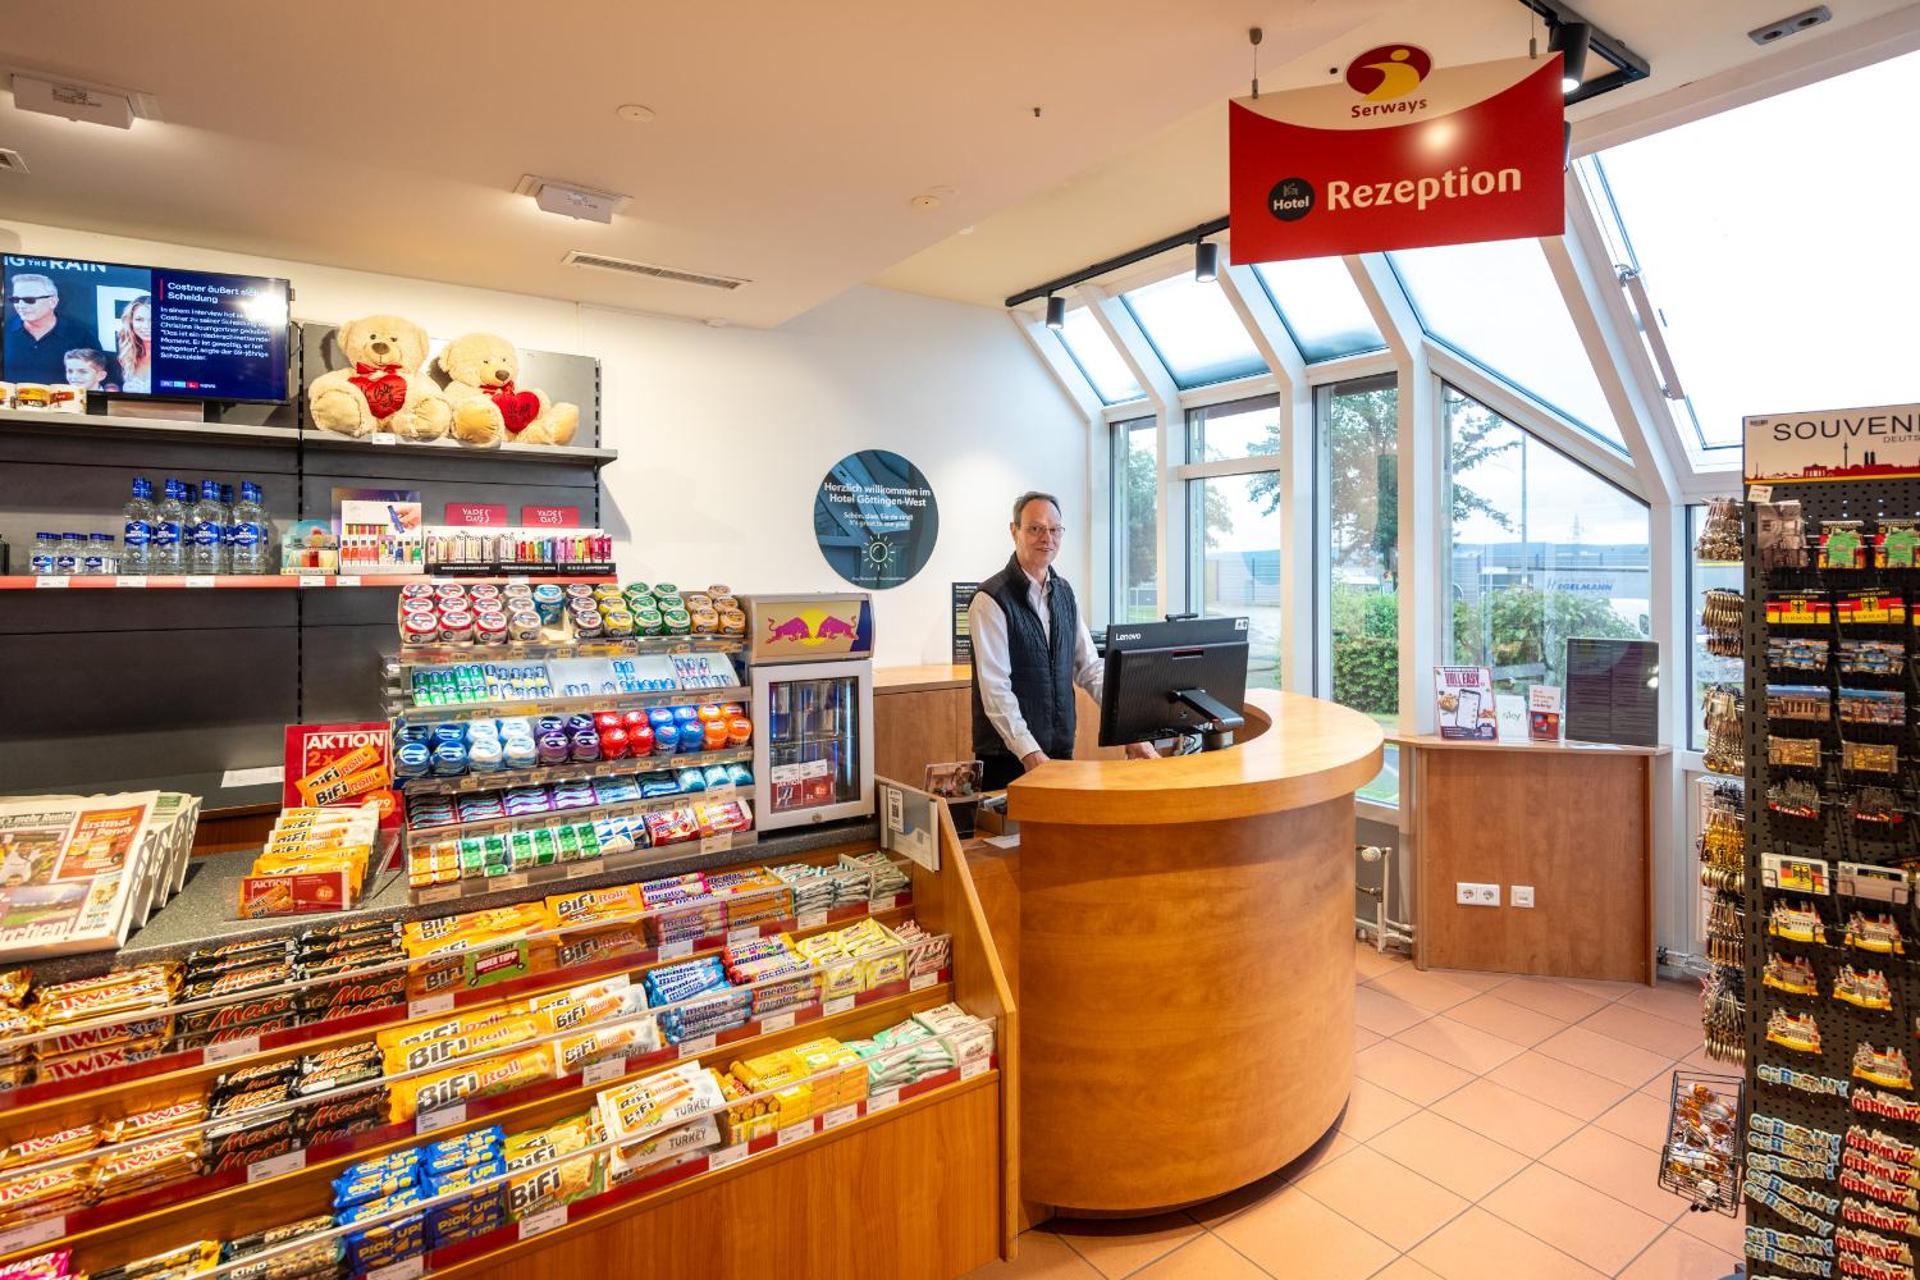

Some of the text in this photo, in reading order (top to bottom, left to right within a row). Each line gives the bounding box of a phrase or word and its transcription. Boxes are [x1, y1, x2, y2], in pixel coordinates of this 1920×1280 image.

[1351, 98, 1427, 118] Serways
[1273, 166, 1522, 211] Hotel Rezeption
[167, 282, 239, 296] Costner äußert
[167, 291, 218, 304] Scheidung
[824, 482, 931, 496] Herzlich willkommen im
[829, 494, 927, 508] Hotel Göttingen-West
[1115, 633, 1142, 641] Lenovo
[306, 733, 384, 750] AKTION
[308, 751, 336, 767] 2x
[315, 774, 374, 806] BiFi Roll
[558, 886, 623, 915] BiFi Roll
[559, 938, 600, 966] BiFi
[426, 967, 465, 990] BiFi
[758, 965, 797, 982] mentos
[330, 977, 406, 1008] Mars
[760, 984, 799, 998] mentos
[208, 999, 290, 1032] Mars
[556, 1004, 586, 1027] BiFi
[686, 1000, 728, 1016] mentos
[57, 1023, 129, 1052] TWIX
[408, 1027, 510, 1071] BiFi Roll
[565, 1038, 596, 1064] BiFi
[45, 1048, 125, 1081] TWIX
[417, 1059, 521, 1113] BiFi Roll
[1757, 1064, 1849, 1098] GERMANY
[127, 1100, 202, 1127] TWIX
[306, 1092, 381, 1132] Mars
[673, 1097, 711, 1118] TURKEY
[11, 1124, 93, 1157] TWIX
[217, 1119, 290, 1155] Mars
[668, 1128, 707, 1150] TURKEY
[1846, 1131, 1915, 1163] GERMANY
[107, 1141, 186, 1175] TWIX
[471, 1162, 498, 1179] UP!
[1843, 1152, 1912, 1183] GERMANY
[509, 1166, 562, 1212] BiFi
[1840, 1173, 1911, 1206] GERMANY
[437, 1198, 498, 1232] PICK UP!
[1842, 1206, 1910, 1231] GERMANY
[358, 1221, 424, 1259] PICK UP!
[1835, 1233, 1902, 1261] GERMANY
